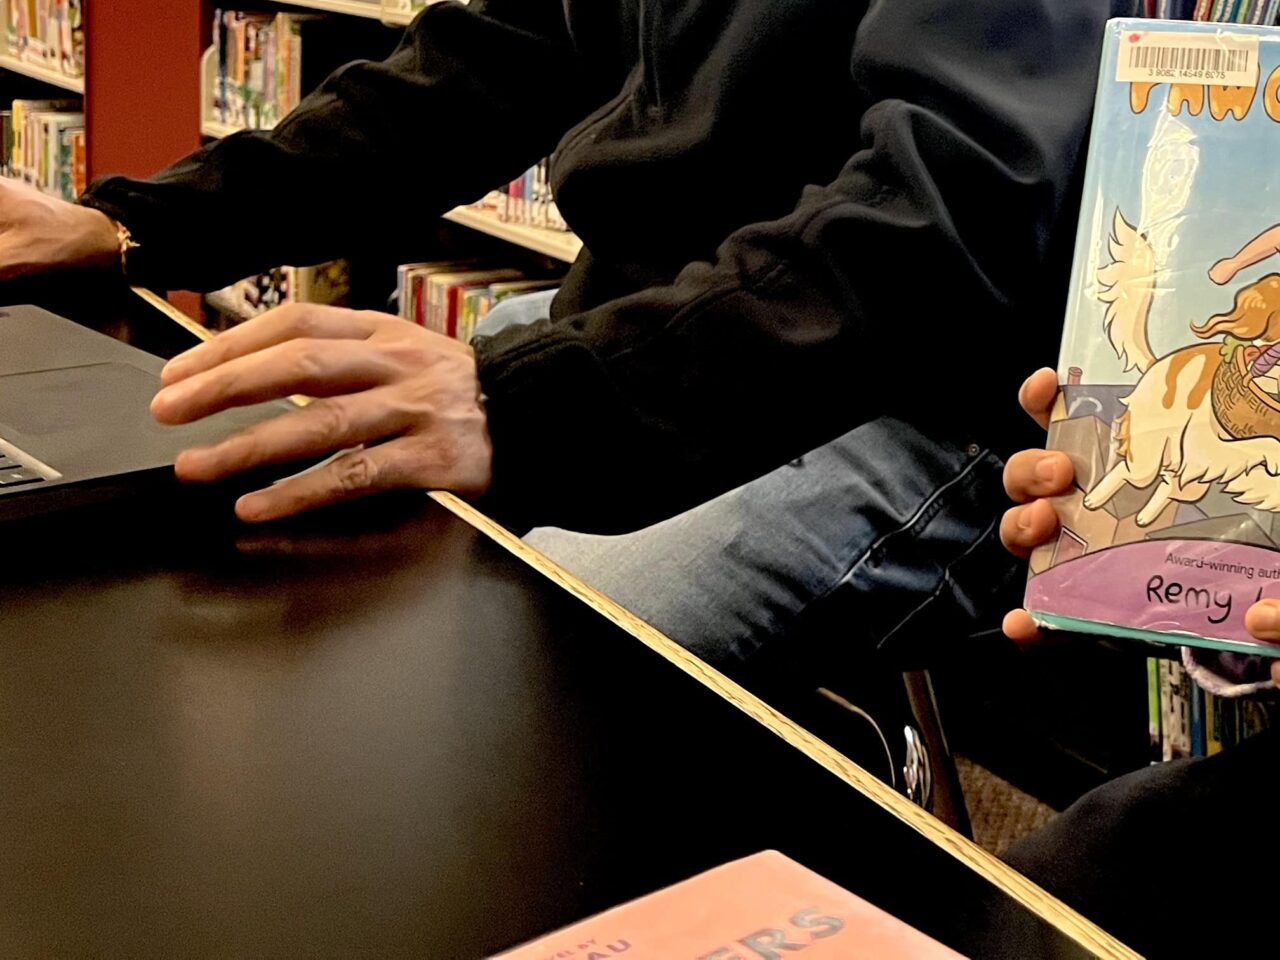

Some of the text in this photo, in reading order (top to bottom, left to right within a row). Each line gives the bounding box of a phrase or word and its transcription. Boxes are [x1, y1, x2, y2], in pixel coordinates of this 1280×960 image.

[1148, 68, 1154, 76] 3
[1164, 552, 1255, 579] Award-winning
[1146, 574, 1233, 625] Remy
